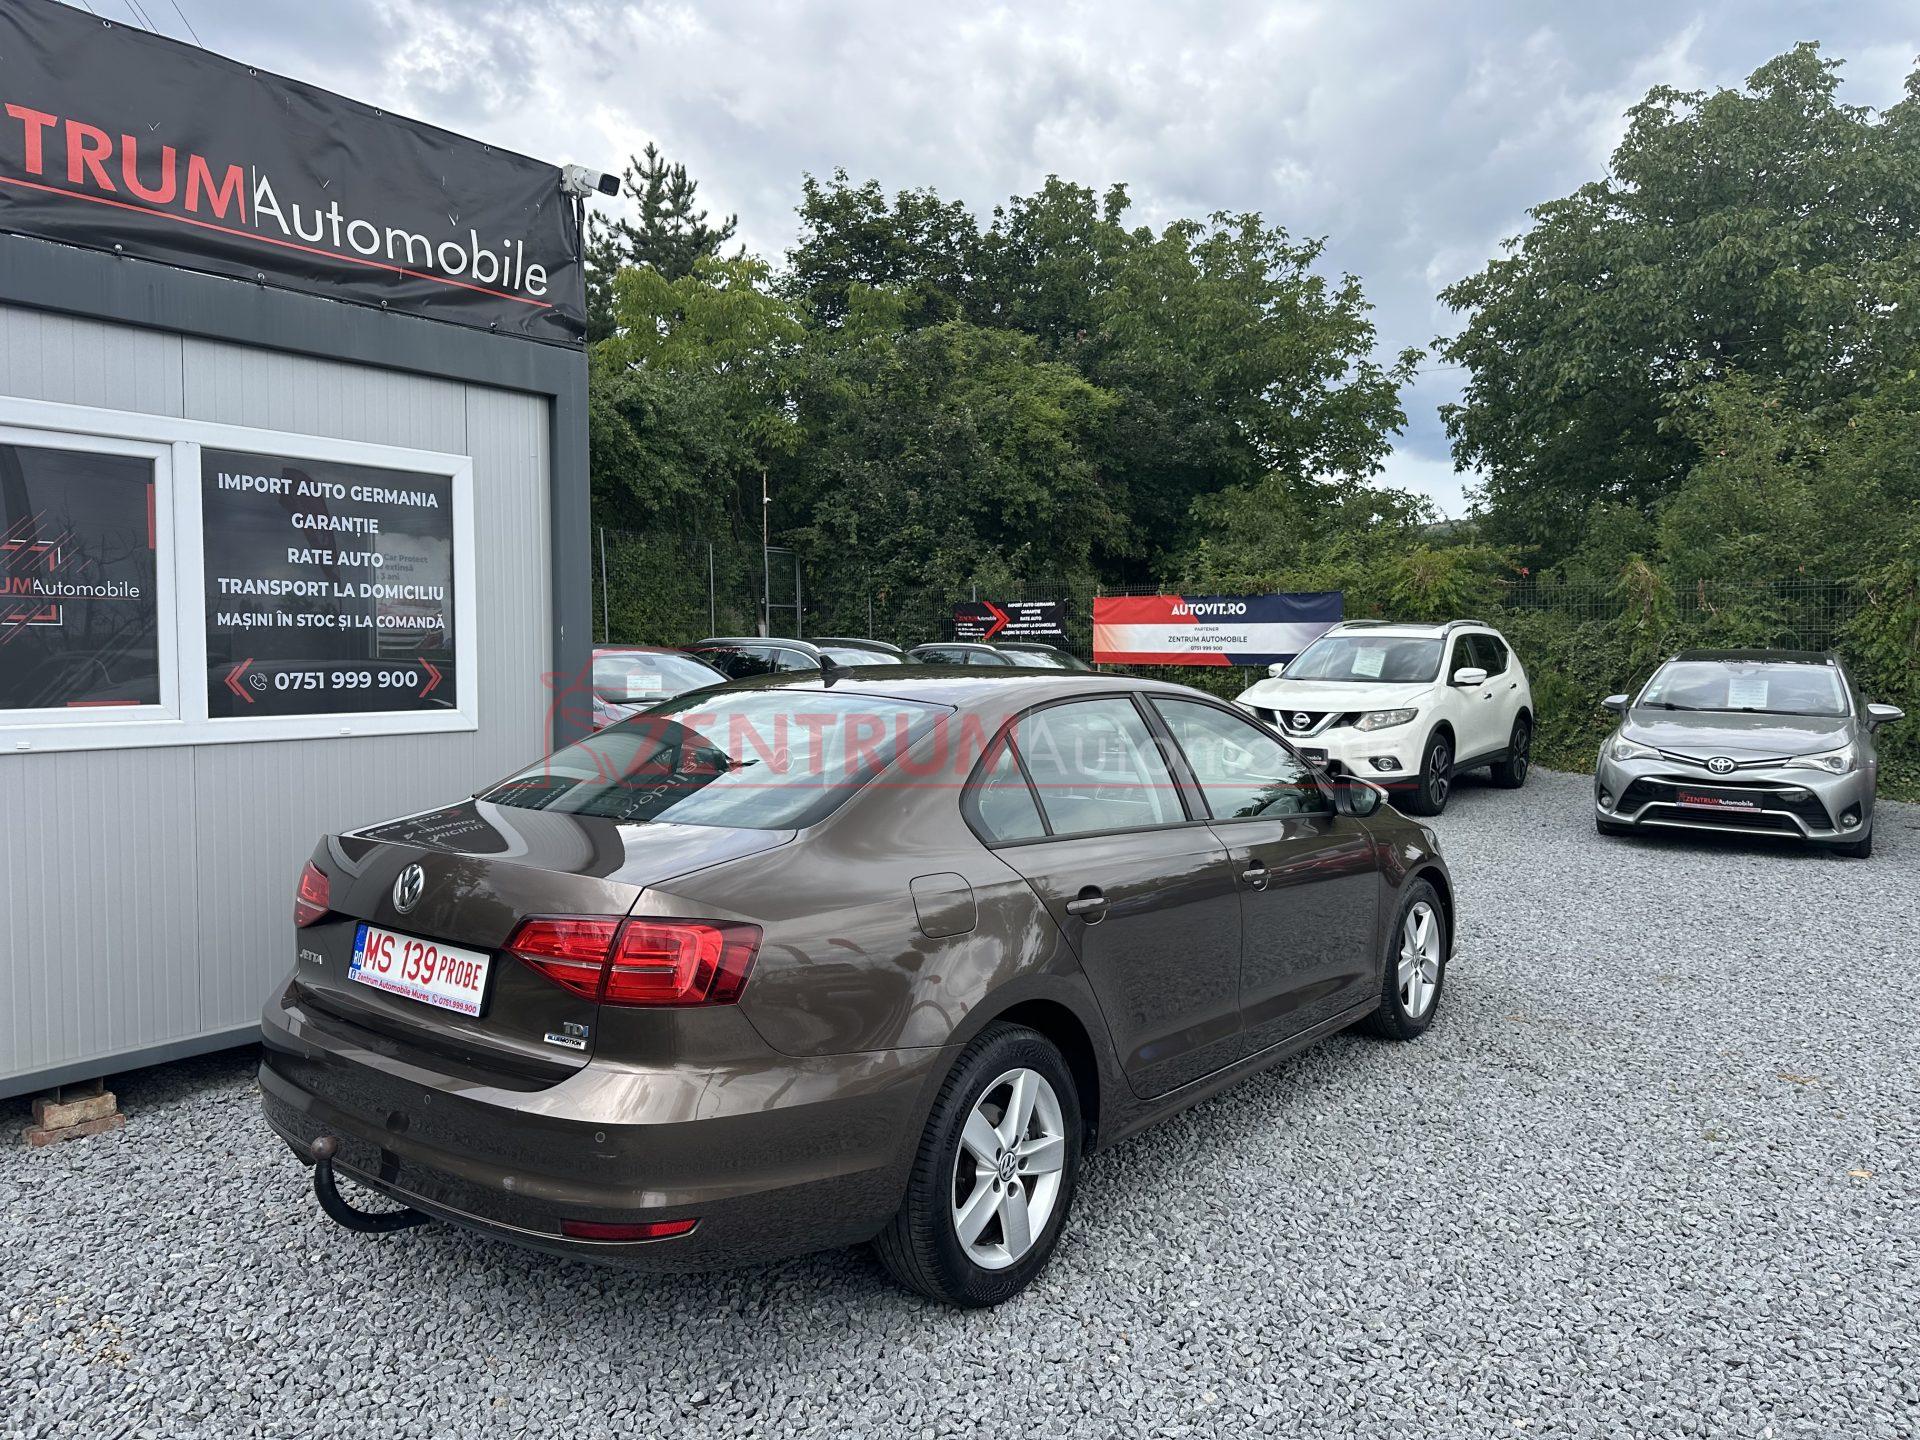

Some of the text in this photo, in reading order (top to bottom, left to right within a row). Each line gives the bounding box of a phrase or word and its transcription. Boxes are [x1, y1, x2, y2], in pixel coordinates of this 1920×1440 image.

[254, 174, 549, 297] Automobile
[217, 472, 439, 508] IMPORT AUTO GERMANIA
[291, 512, 380, 538] GARANȚIE
[287, 547, 384, 568] RATE AUTO
[33, 578, 140, 598] Automobile
[217, 577, 445, 601] TRANSPORT LA DOMICILIU
[1170, 602, 1247, 616] AUTOVIT.RO
[217, 610, 445, 632] MAȘINI ÎN STOC ȘI LA COMANDĂ
[1167, 635, 1248, 643] ZENTRUM AUTOMOBILE
[274, 670, 418, 691] 0751 999 900
[353, 931, 483, 992] RO MS 139 PROBE
[357, 972, 379, 987] Zentrum
[379, 980, 411, 996] Automobile
[563, 1021, 589, 1038] TDI
